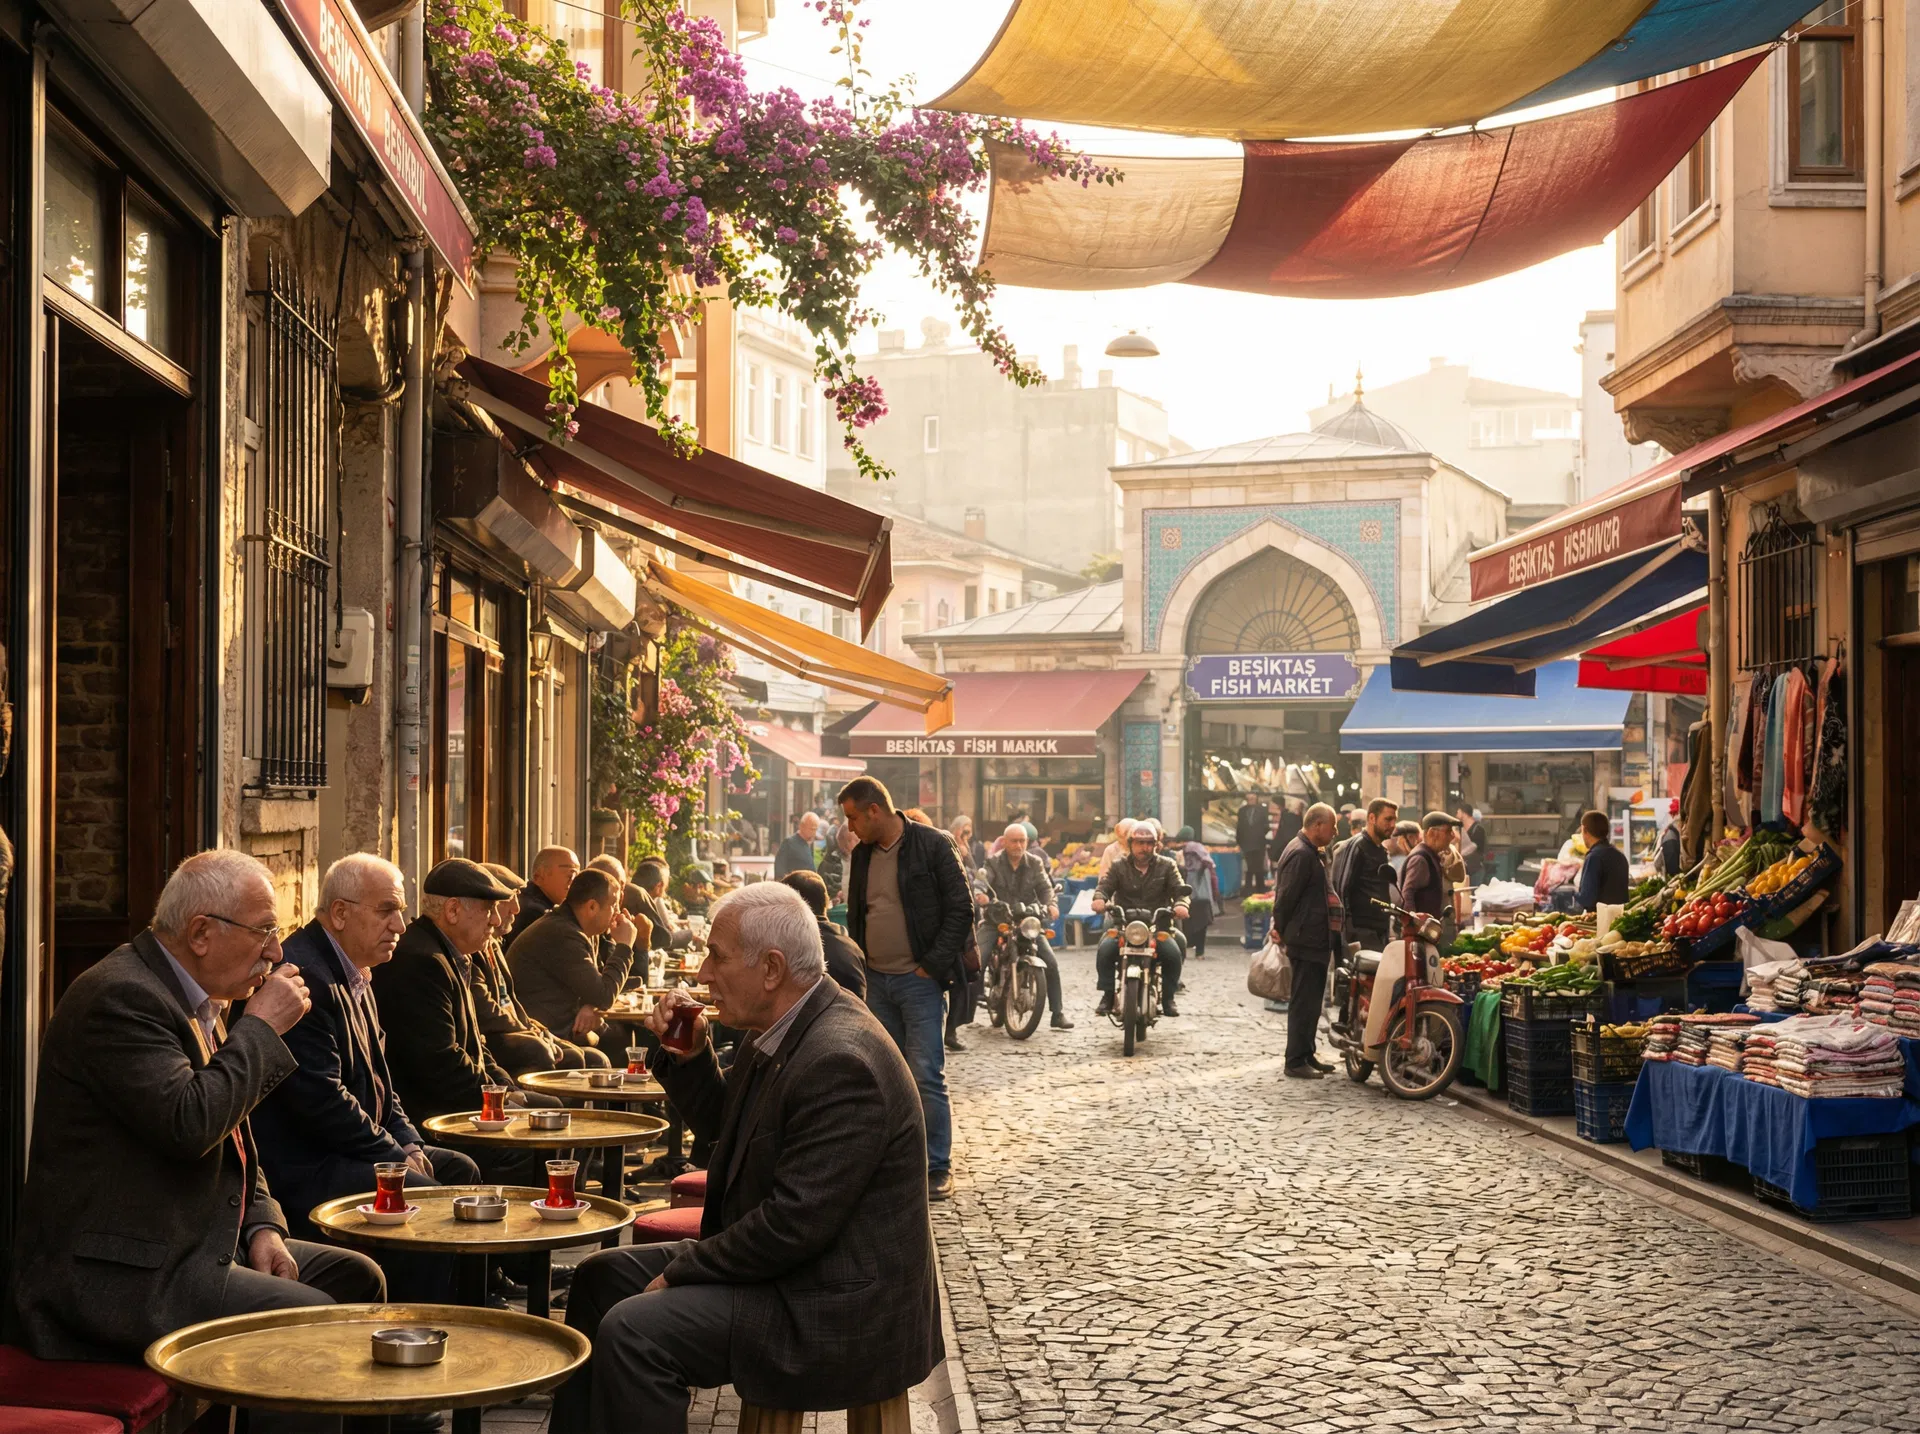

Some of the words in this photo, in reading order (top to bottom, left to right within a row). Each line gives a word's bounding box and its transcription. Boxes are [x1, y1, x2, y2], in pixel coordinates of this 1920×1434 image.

[319, 0, 371, 130] BEŞİKTAŞ
[1508, 540, 1555, 586] BEŞİKTAŞ
[1228, 656, 1316, 677] BEŞİKTAŞ
[1211, 676, 1251, 695] FİSH
[1257, 677, 1333, 694] MARKET
[886, 737, 956, 755] BEŞİKTAŞ
[963, 737, 997, 753] FİSH
[1003, 739, 1058, 753] MARKK
